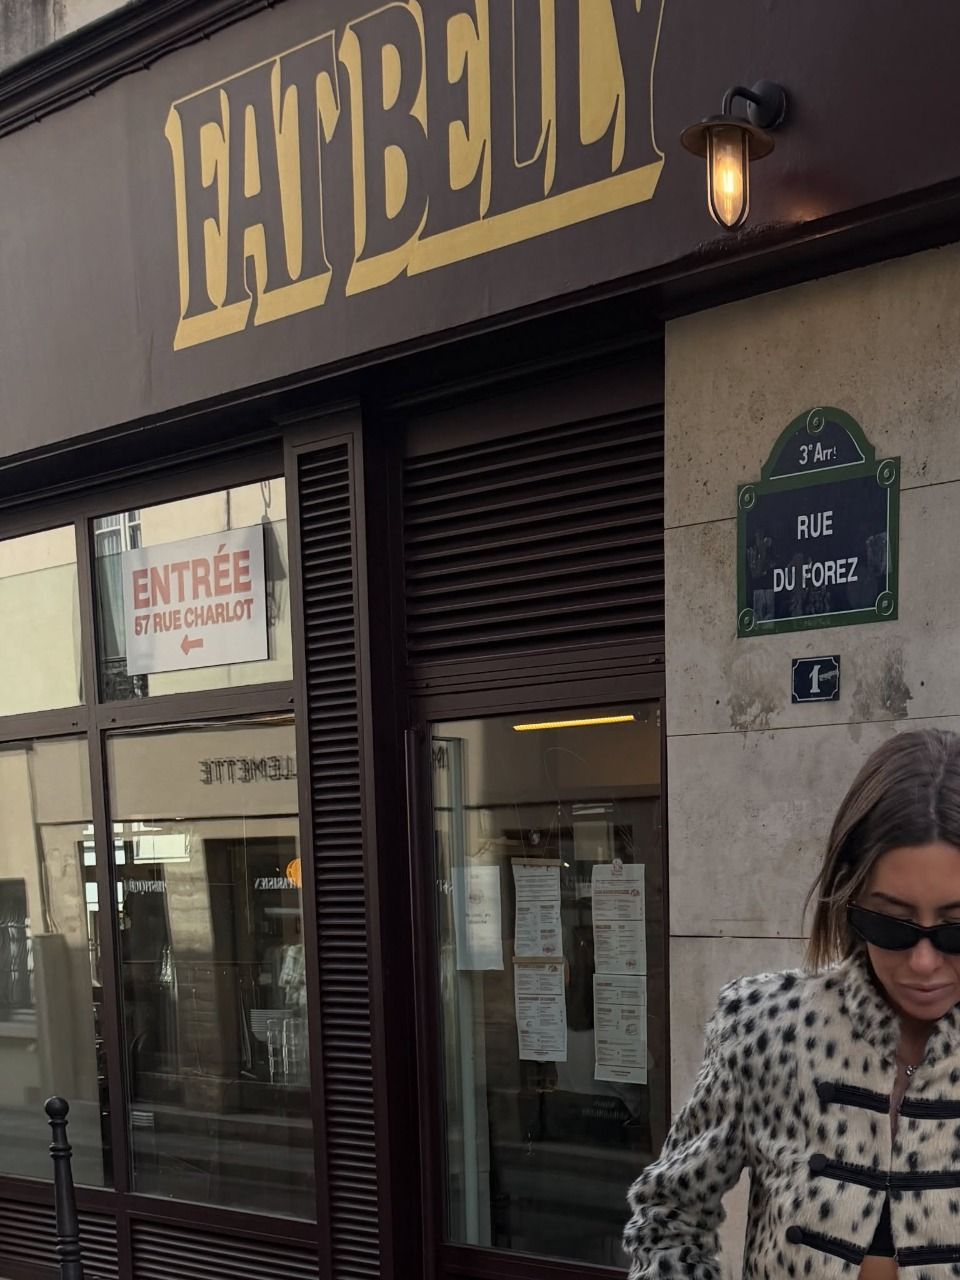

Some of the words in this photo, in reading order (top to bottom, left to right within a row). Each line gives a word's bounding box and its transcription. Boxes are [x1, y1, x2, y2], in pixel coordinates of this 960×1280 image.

[797, 511, 833, 540] RUE
[132, 544, 252, 610] ENTRÉE
[773, 566, 795, 592] DU
[802, 557, 858, 588] FOREZ
[134, 614, 150, 636] 57
[153, 610, 182, 634] RUE
[184, 598, 254, 628] CHARLOT
[809, 664, 821, 693] 1
